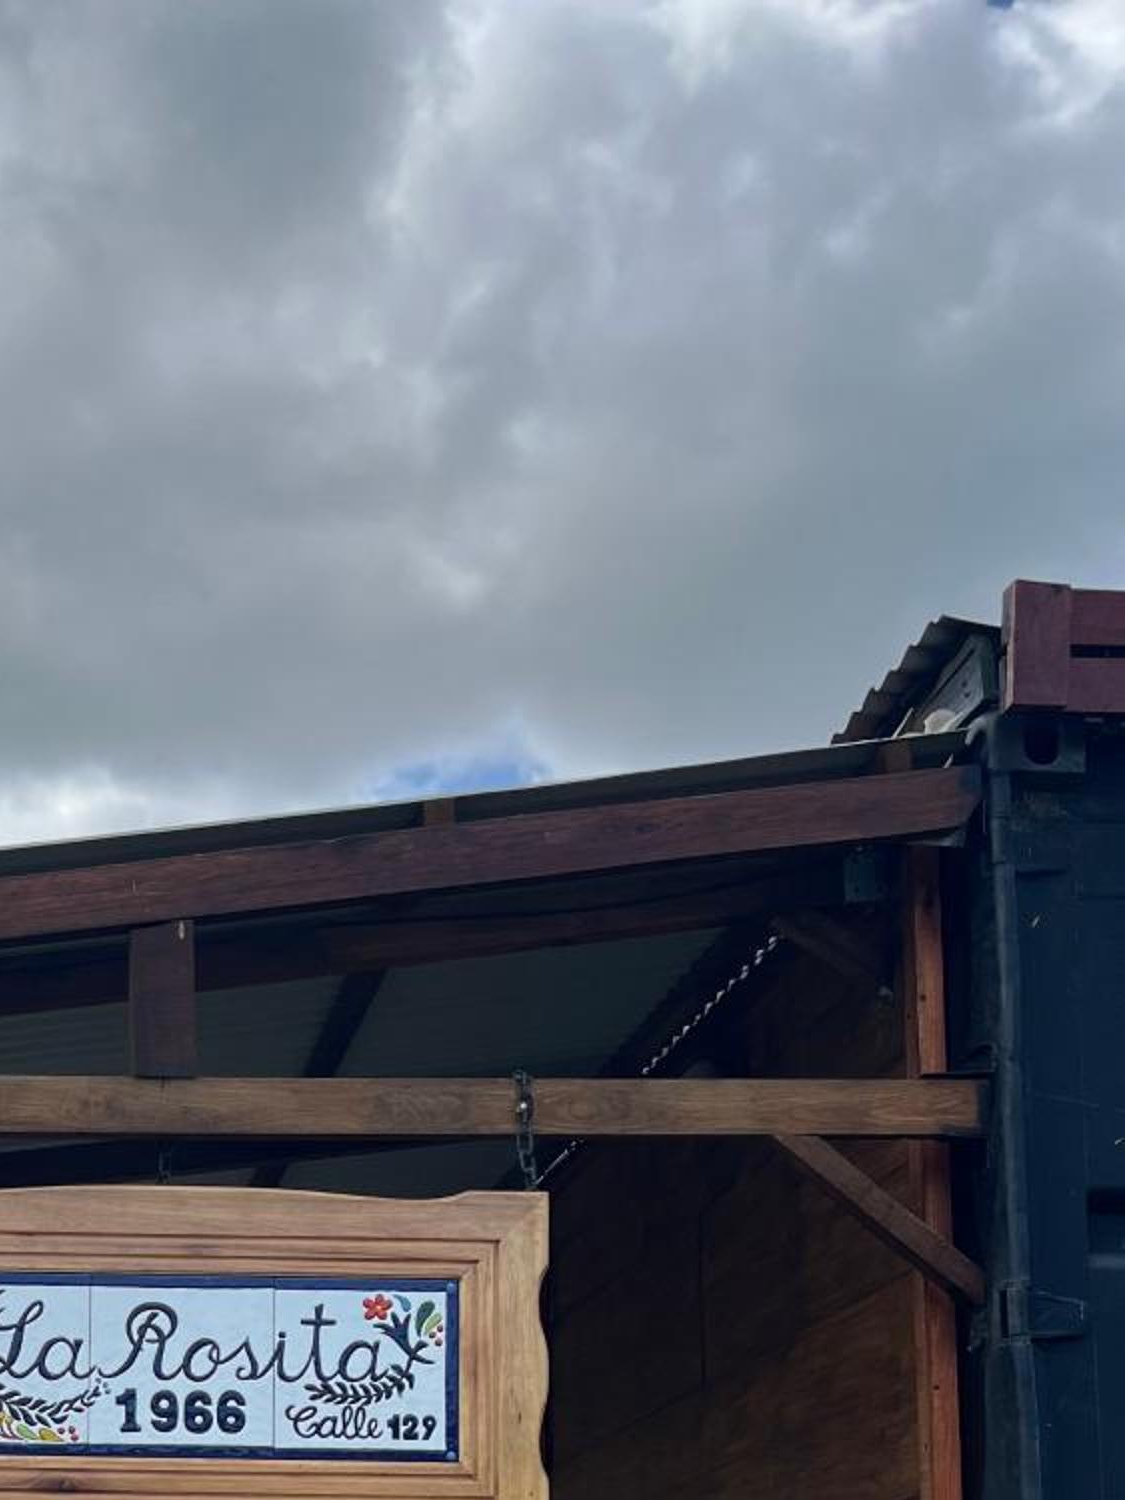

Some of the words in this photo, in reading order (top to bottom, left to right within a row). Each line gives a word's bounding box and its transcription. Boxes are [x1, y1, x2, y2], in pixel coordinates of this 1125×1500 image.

[97, 1301, 397, 1383] Rosita
[115, 1388, 246, 1434] 1966
[285, 1403, 383, 1440] Calle
[386, 1413, 437, 1441] 129
